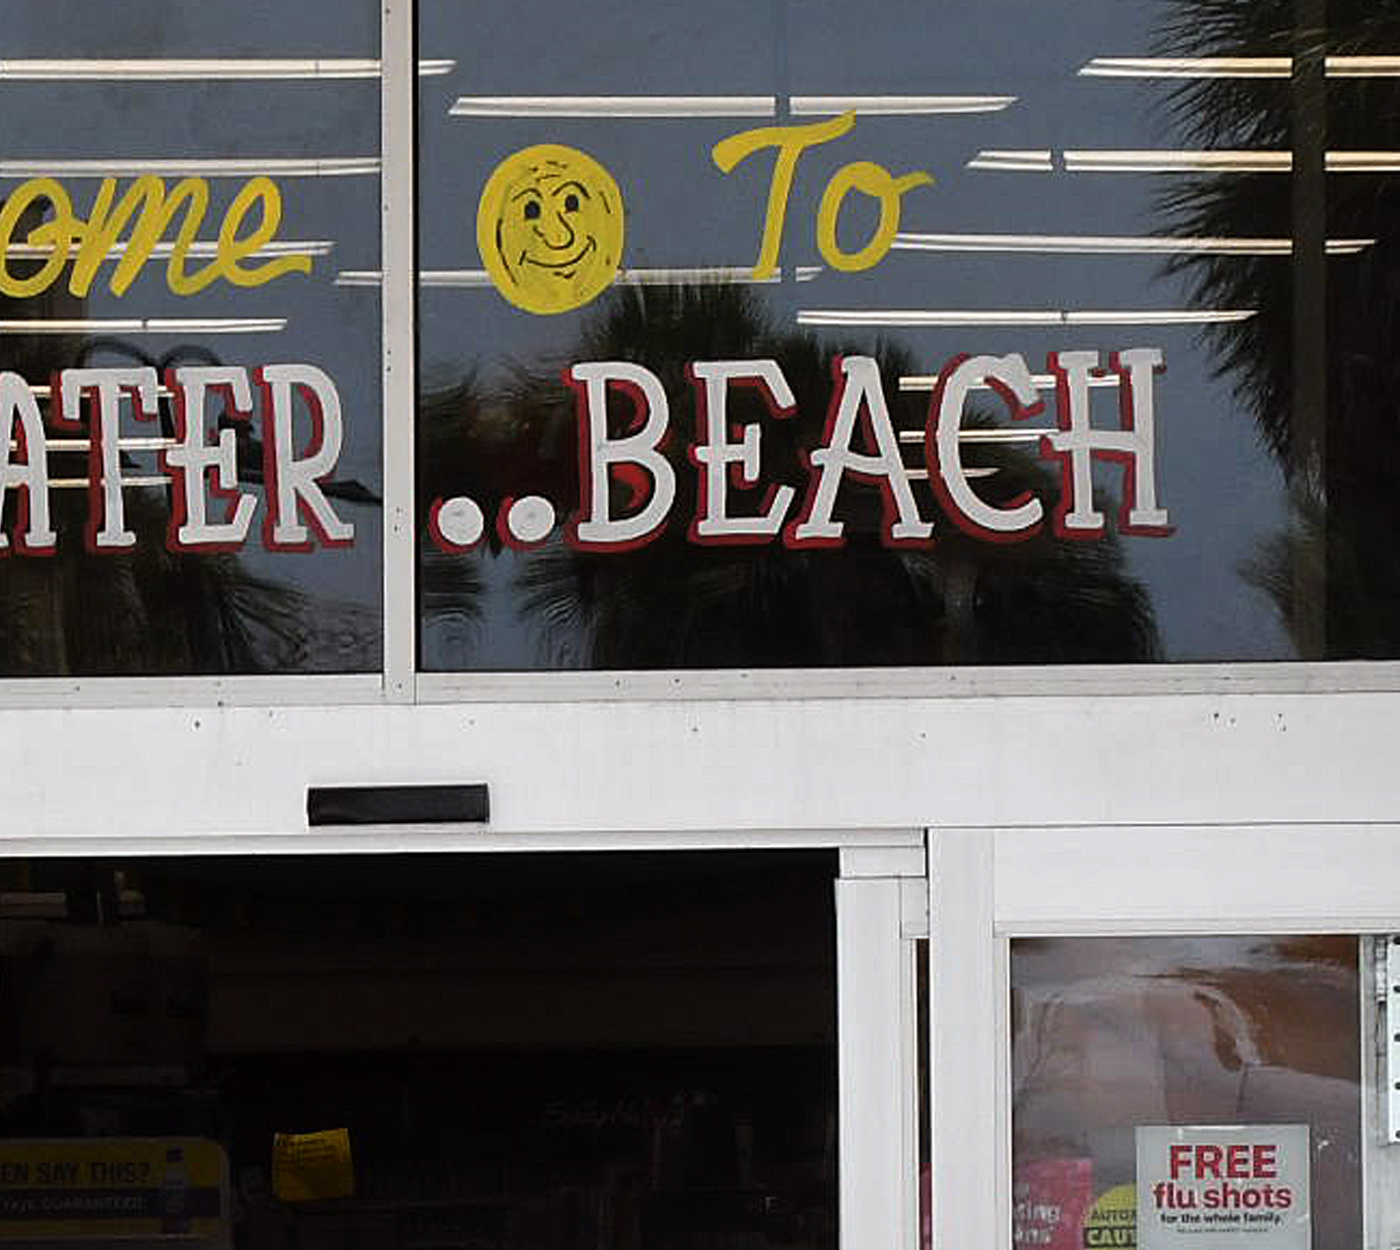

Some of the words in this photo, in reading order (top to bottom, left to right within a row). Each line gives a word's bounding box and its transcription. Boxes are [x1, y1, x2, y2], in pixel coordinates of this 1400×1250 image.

[711, 110, 937, 283] To
[1169, 1144, 1278, 1180] FREE
[1153, 1181, 1196, 1209] flu
[1203, 1182, 1293, 1210] shots
[1160, 1212, 1179, 1224] for
[1181, 1212, 1201, 1224] the
[1205, 1212, 1241, 1224] whole
